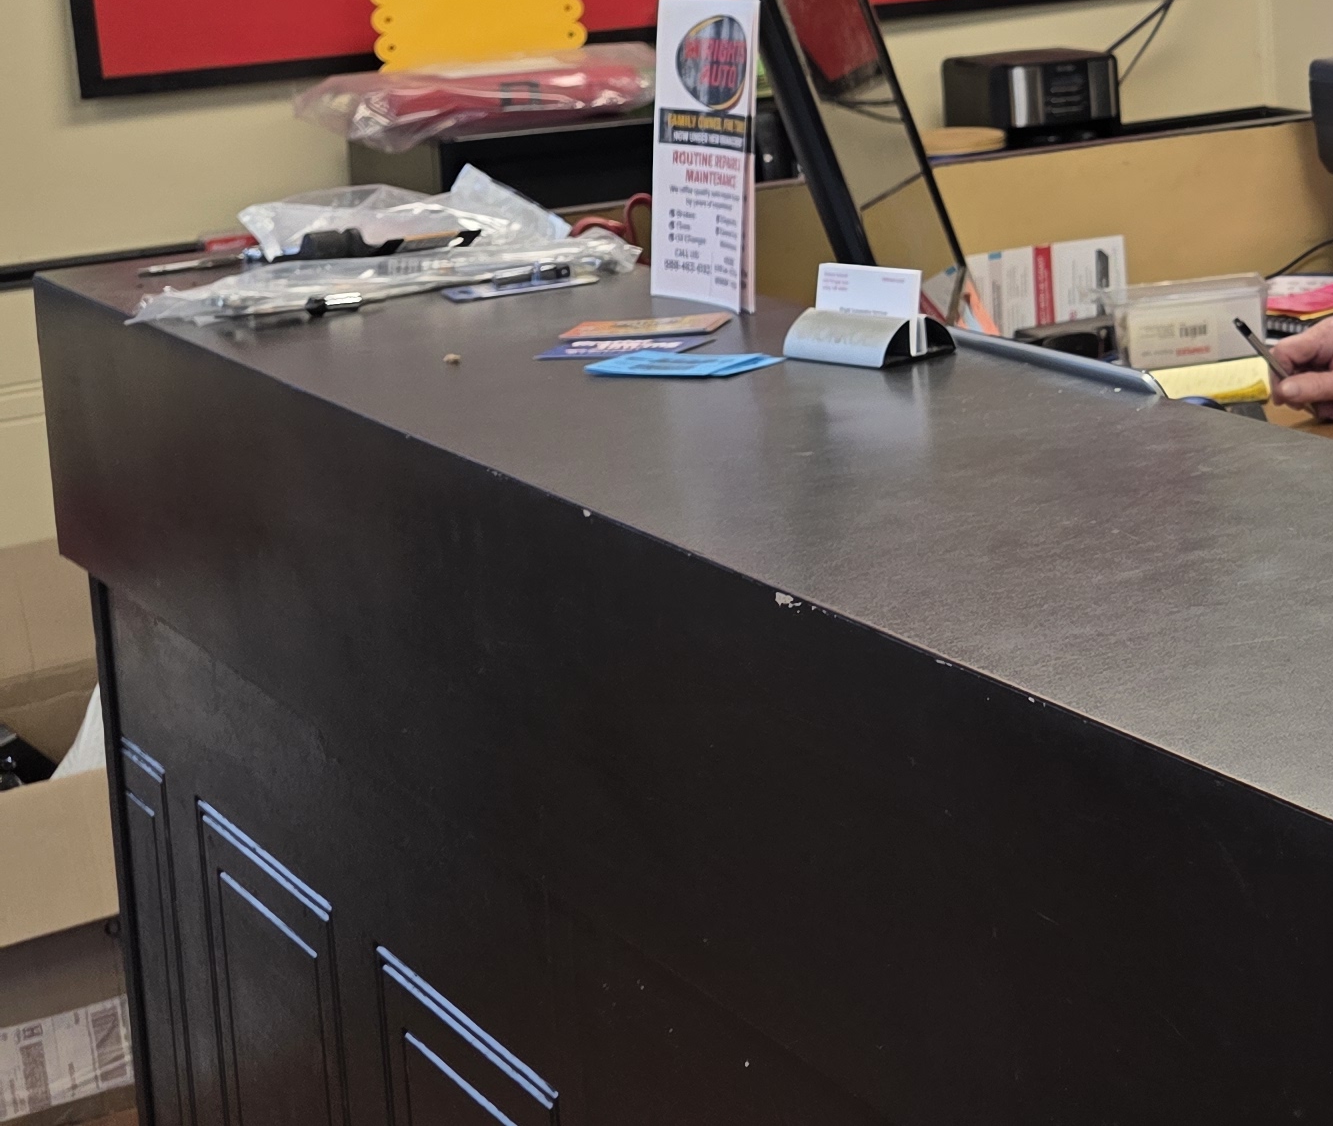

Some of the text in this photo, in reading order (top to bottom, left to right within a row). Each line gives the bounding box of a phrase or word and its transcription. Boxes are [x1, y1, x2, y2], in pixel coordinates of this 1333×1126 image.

[701, 64, 737, 88] AUTO
[673, 150, 714, 168] ROUTINE
[685, 169, 737, 189] MAINTENANCE
